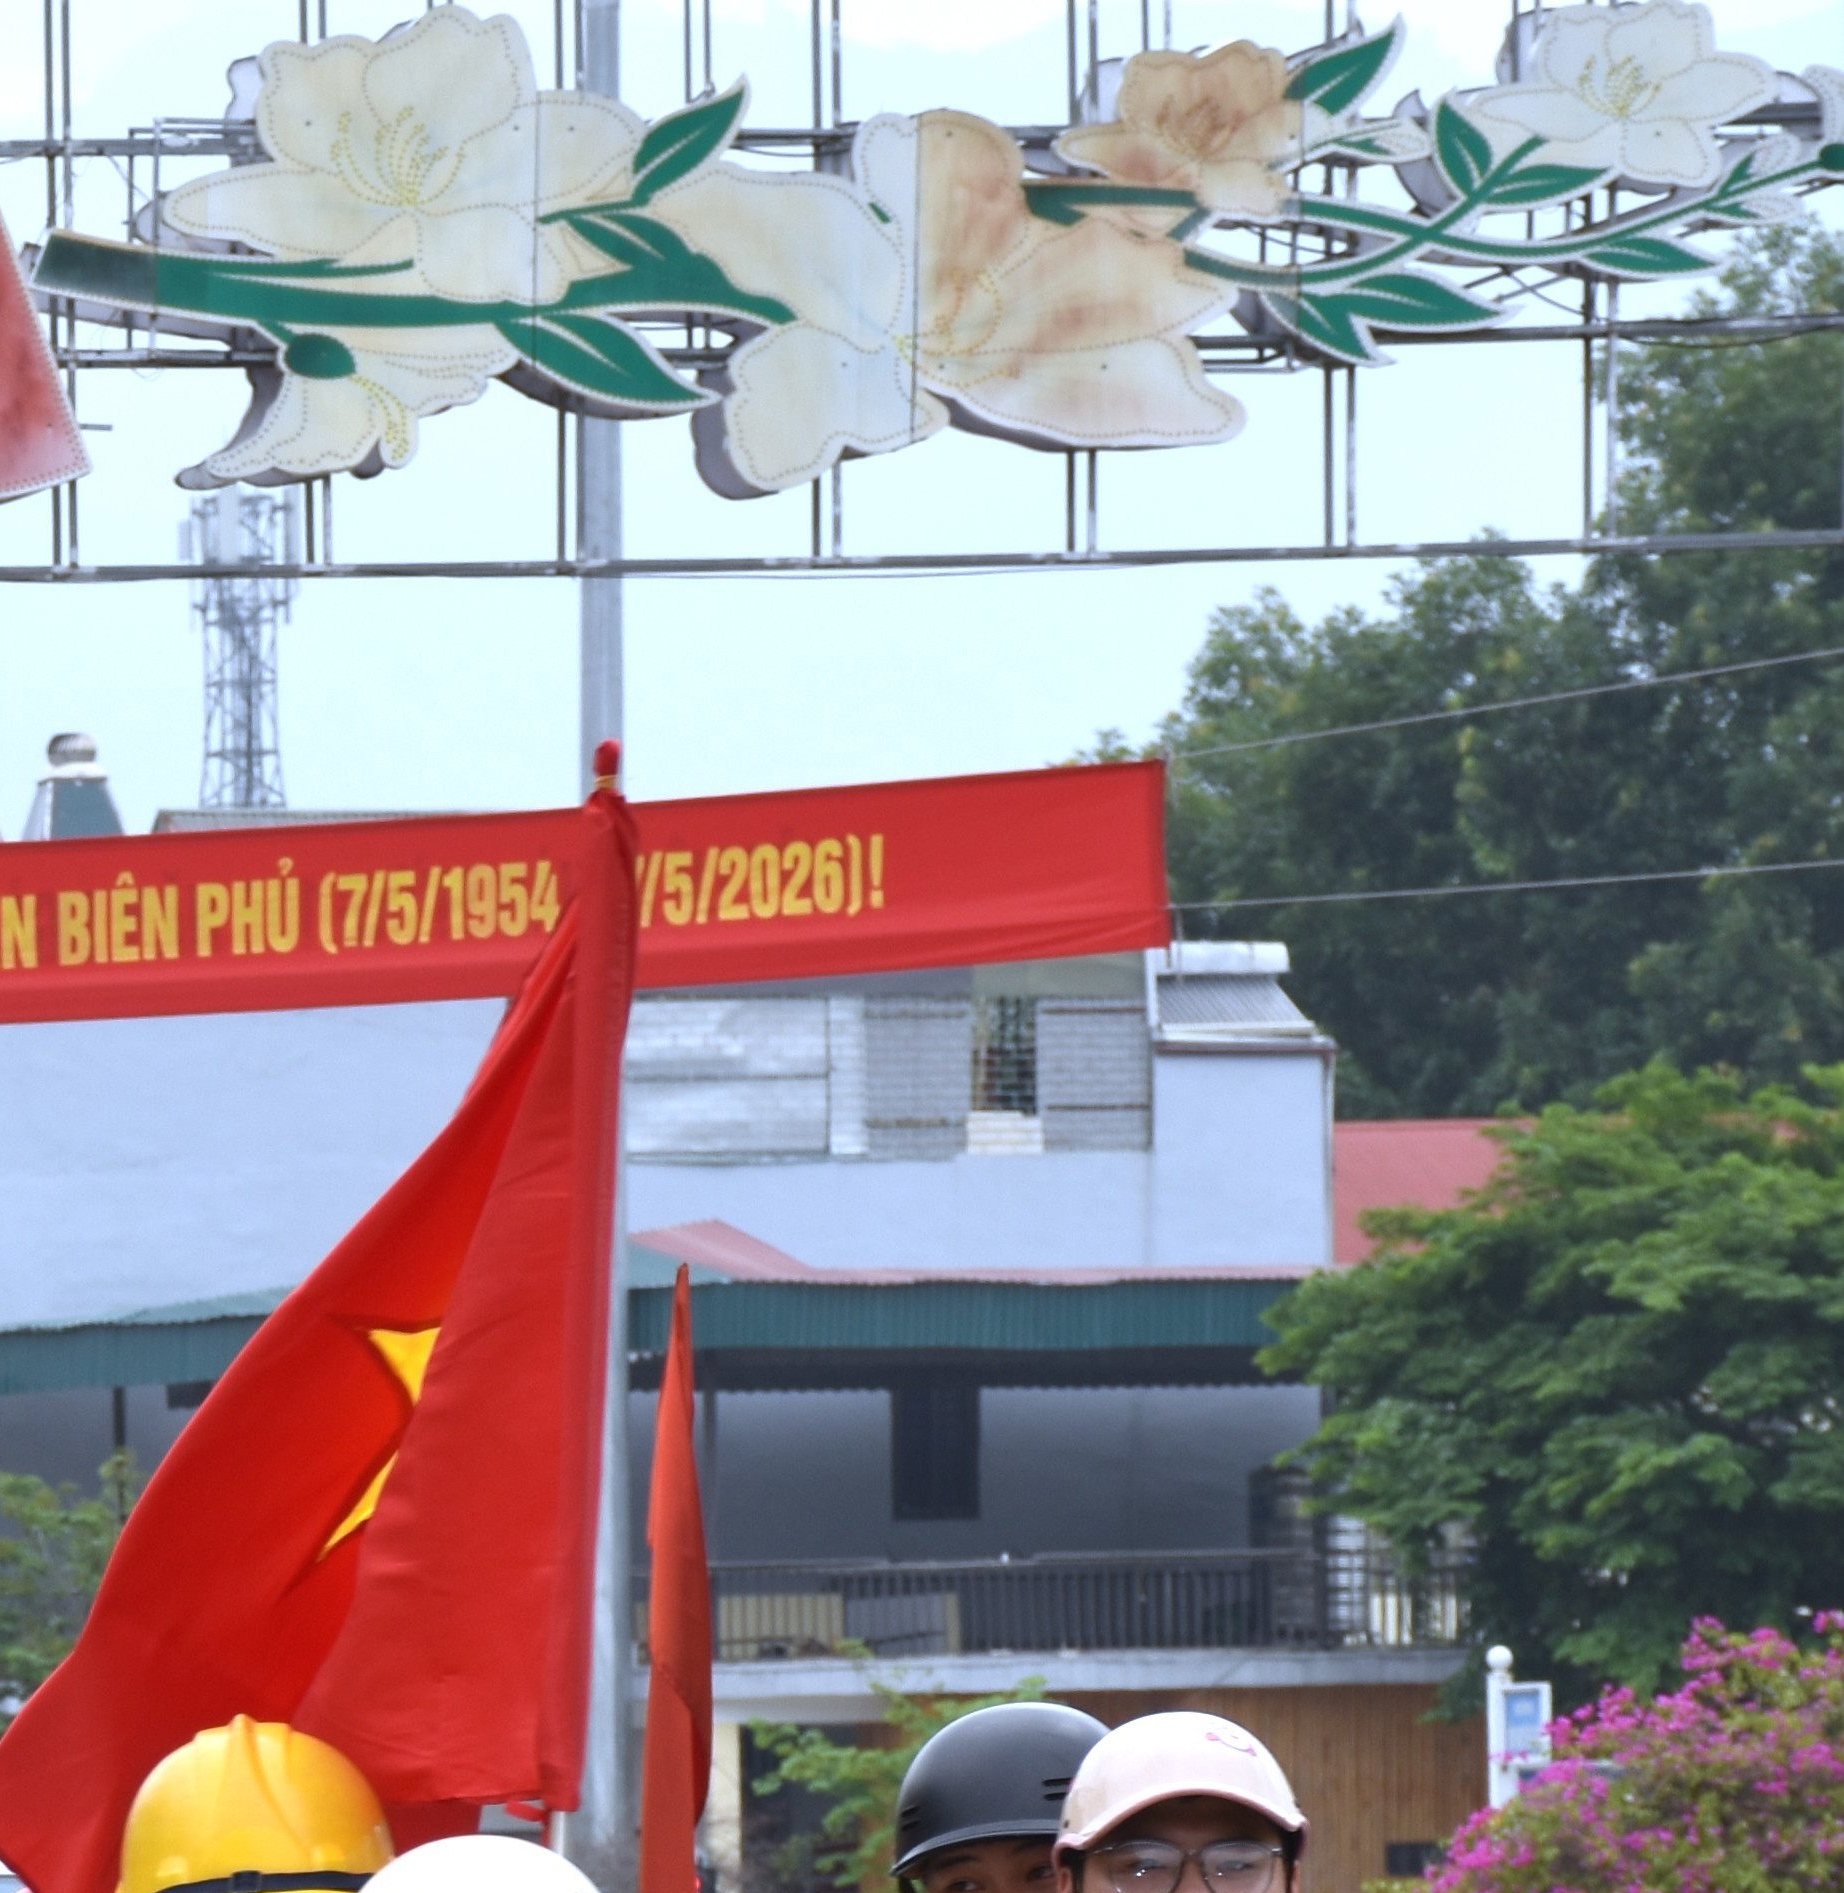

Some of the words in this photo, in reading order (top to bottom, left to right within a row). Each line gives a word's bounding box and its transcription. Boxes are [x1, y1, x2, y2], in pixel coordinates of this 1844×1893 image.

[59, 870, 180, 966] BIÊN
[195, 856, 300, 958] PHỦ
[318, 860, 561, 954] (7/5/1954
[636, 833, 885, 926] /5/2026)!
